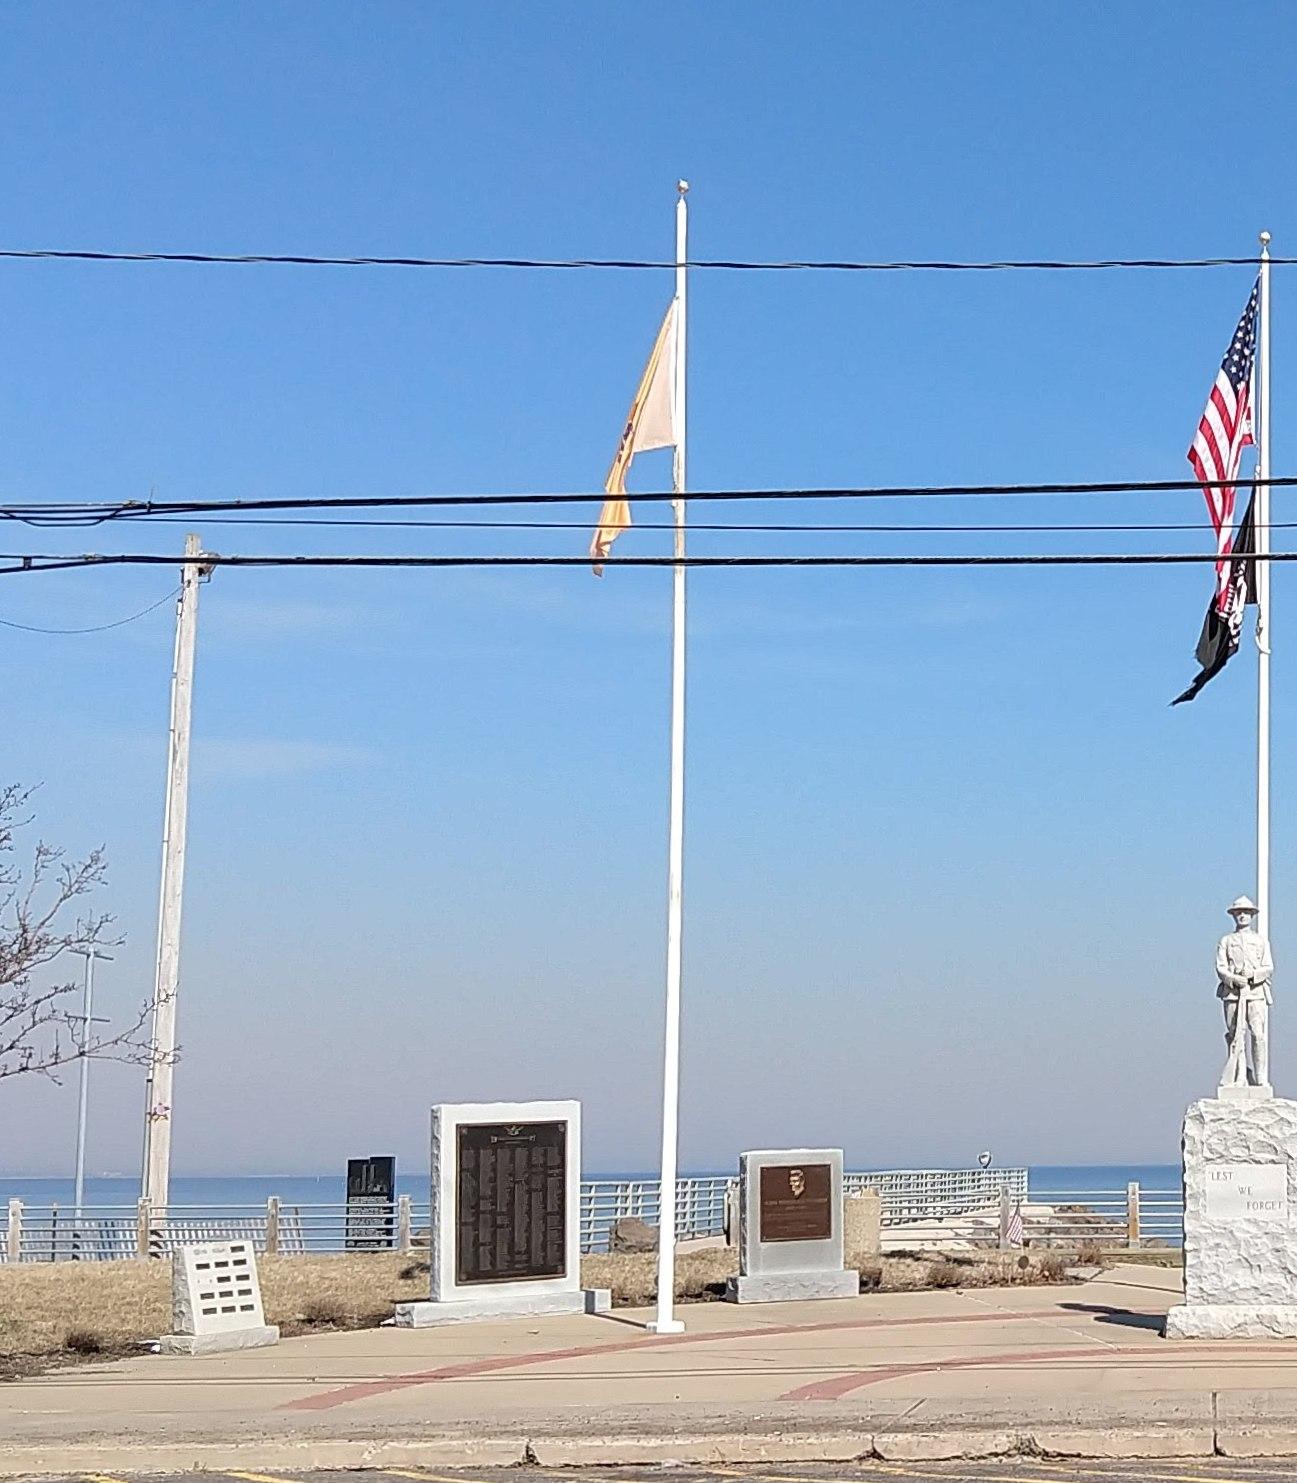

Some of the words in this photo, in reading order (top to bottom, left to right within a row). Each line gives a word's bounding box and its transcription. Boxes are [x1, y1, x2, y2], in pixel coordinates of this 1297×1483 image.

[1211, 1171, 1233, 1181] LEST
[1238, 1186, 1253, 1196] WE
[1246, 1201, 1283, 1210] FORGET
